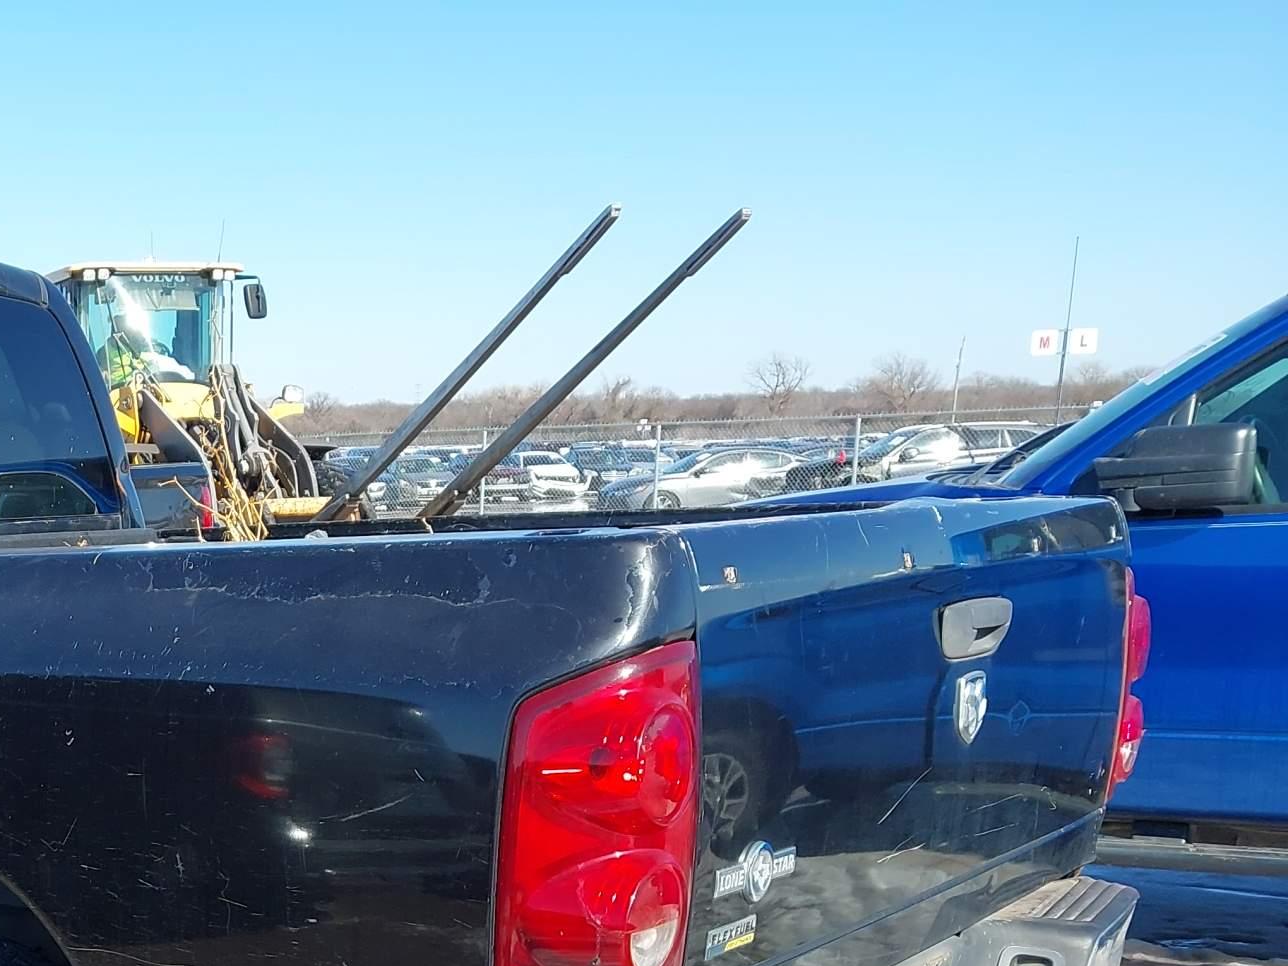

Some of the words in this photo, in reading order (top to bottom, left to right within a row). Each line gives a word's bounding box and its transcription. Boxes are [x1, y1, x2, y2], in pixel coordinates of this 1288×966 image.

[132, 274, 186, 283] VOLVO
[1039, 336, 1050, 349] M
[1079, 335, 1088, 348] L
[719, 869, 746, 892] LONE
[772, 853, 796, 875] STAR
